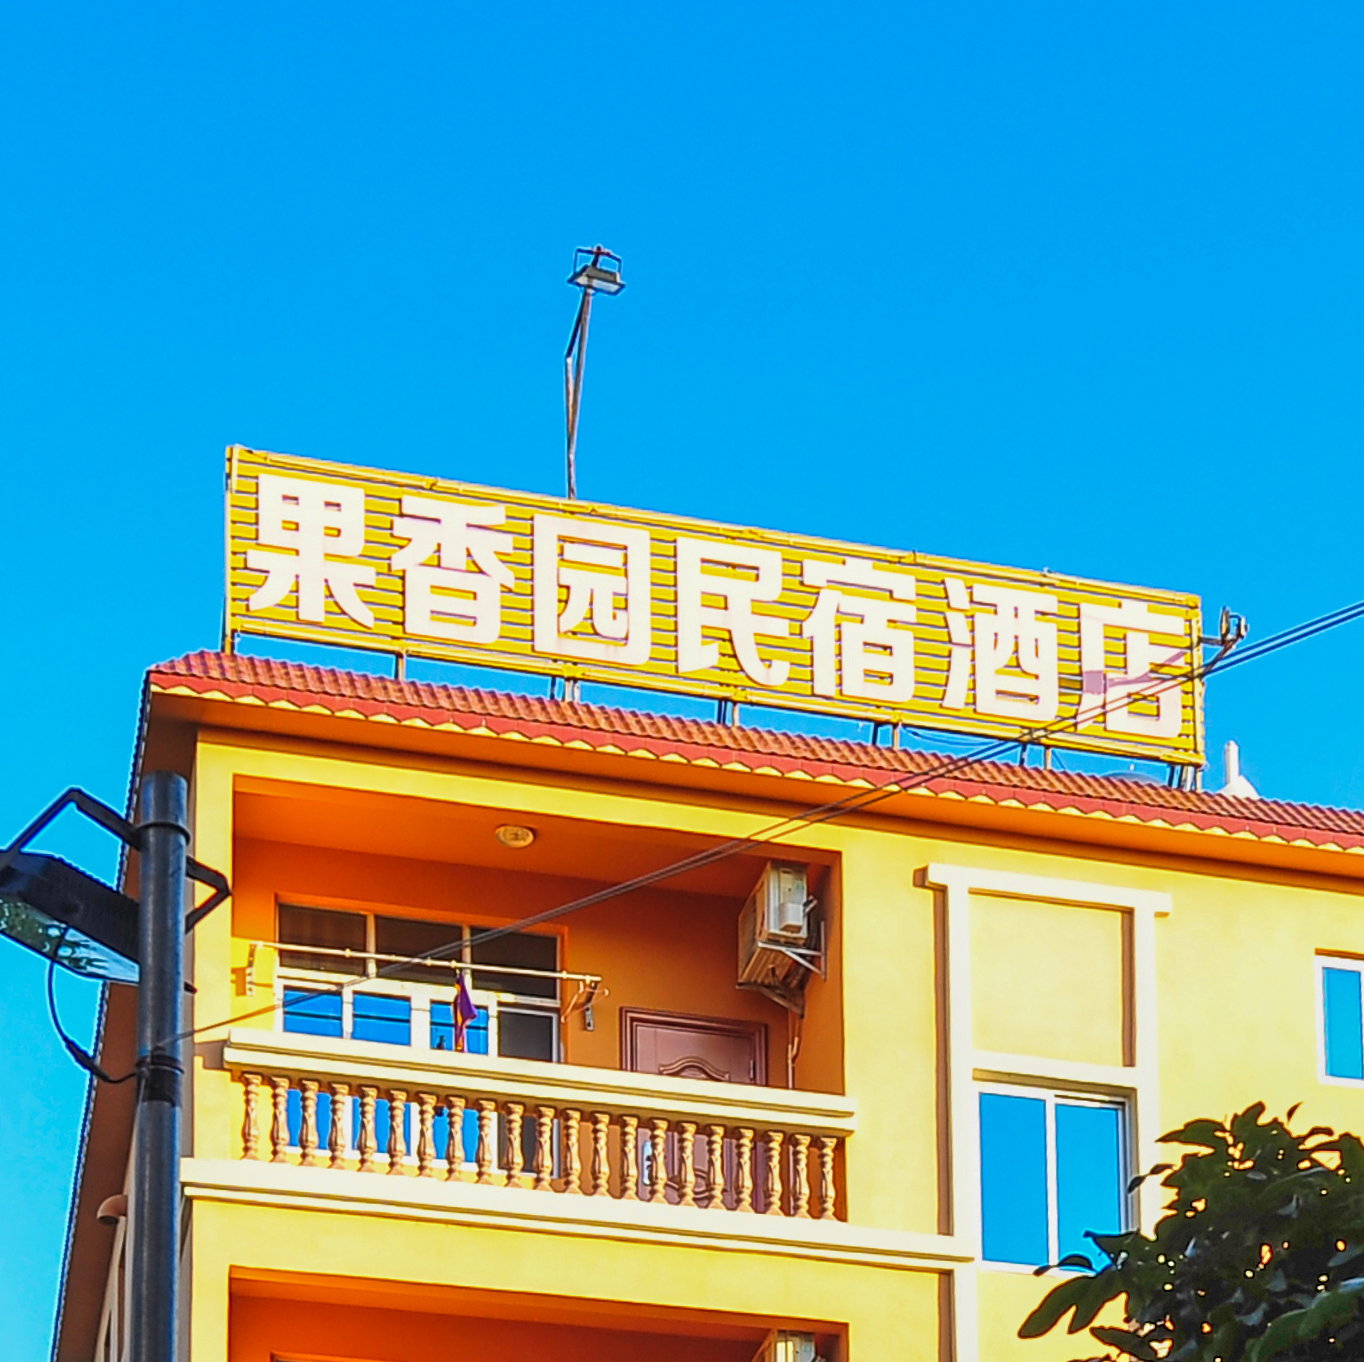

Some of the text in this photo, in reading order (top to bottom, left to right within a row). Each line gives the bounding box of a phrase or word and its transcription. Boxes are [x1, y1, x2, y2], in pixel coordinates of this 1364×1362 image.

[246, 473, 1184, 738] 果香园民宿酒店
